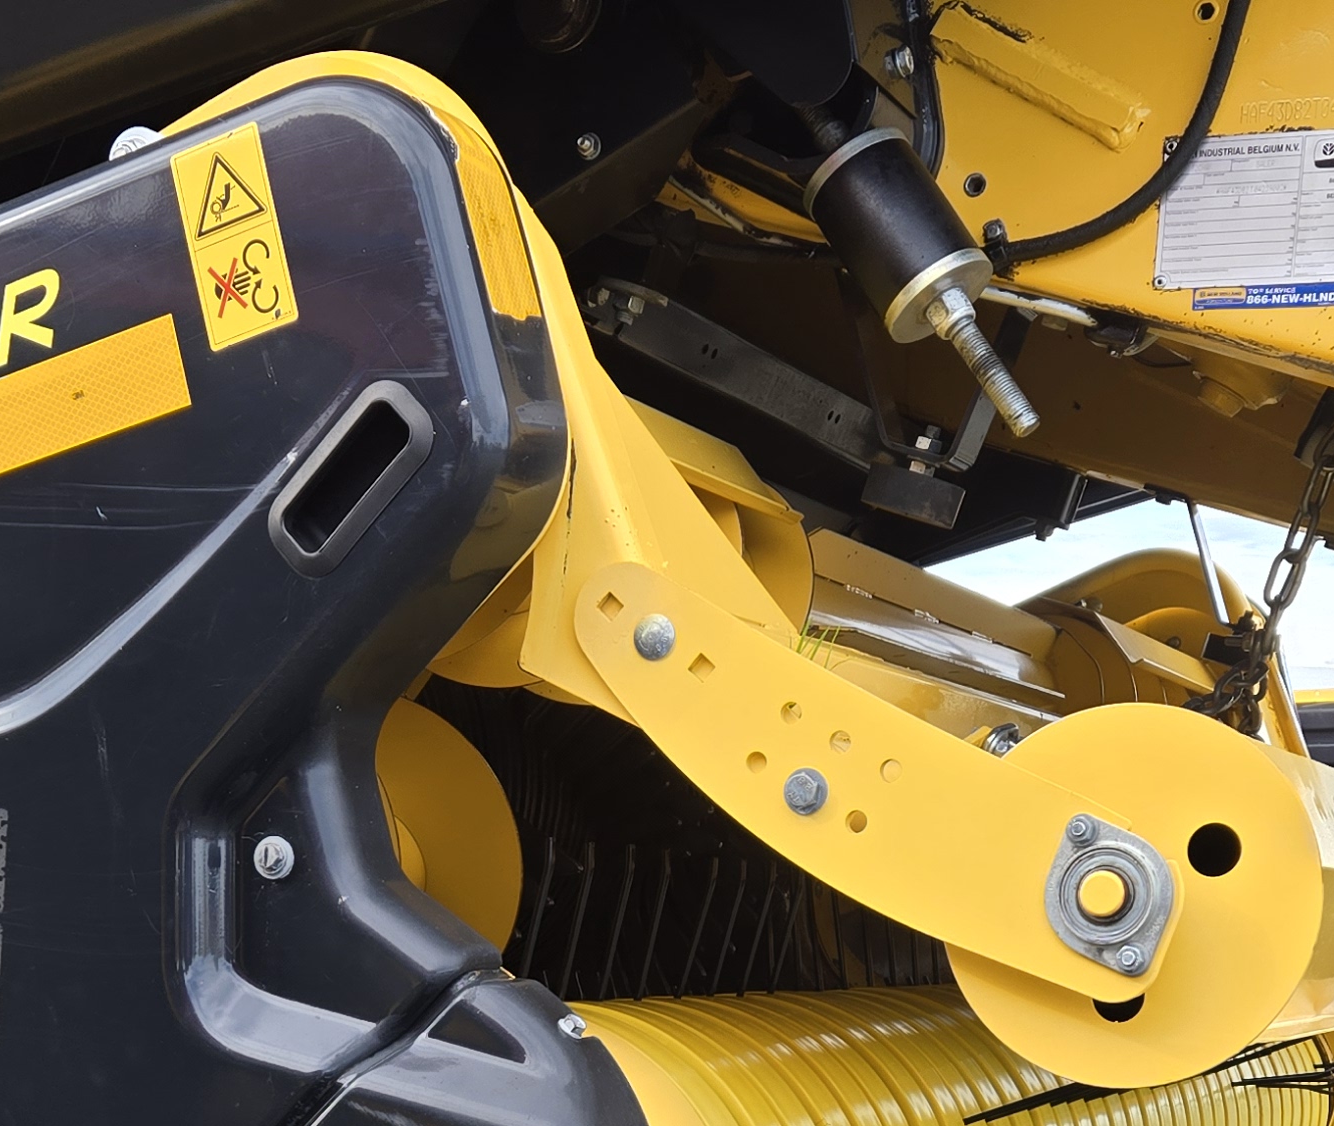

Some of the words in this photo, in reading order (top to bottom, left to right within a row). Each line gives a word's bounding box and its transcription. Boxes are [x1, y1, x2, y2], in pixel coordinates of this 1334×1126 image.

[1199, 147, 1245, 158] INDUSTRIAL
[1247, 144, 1284, 154] BELGIUM
[1285, 143, 1300, 152] N.V.
